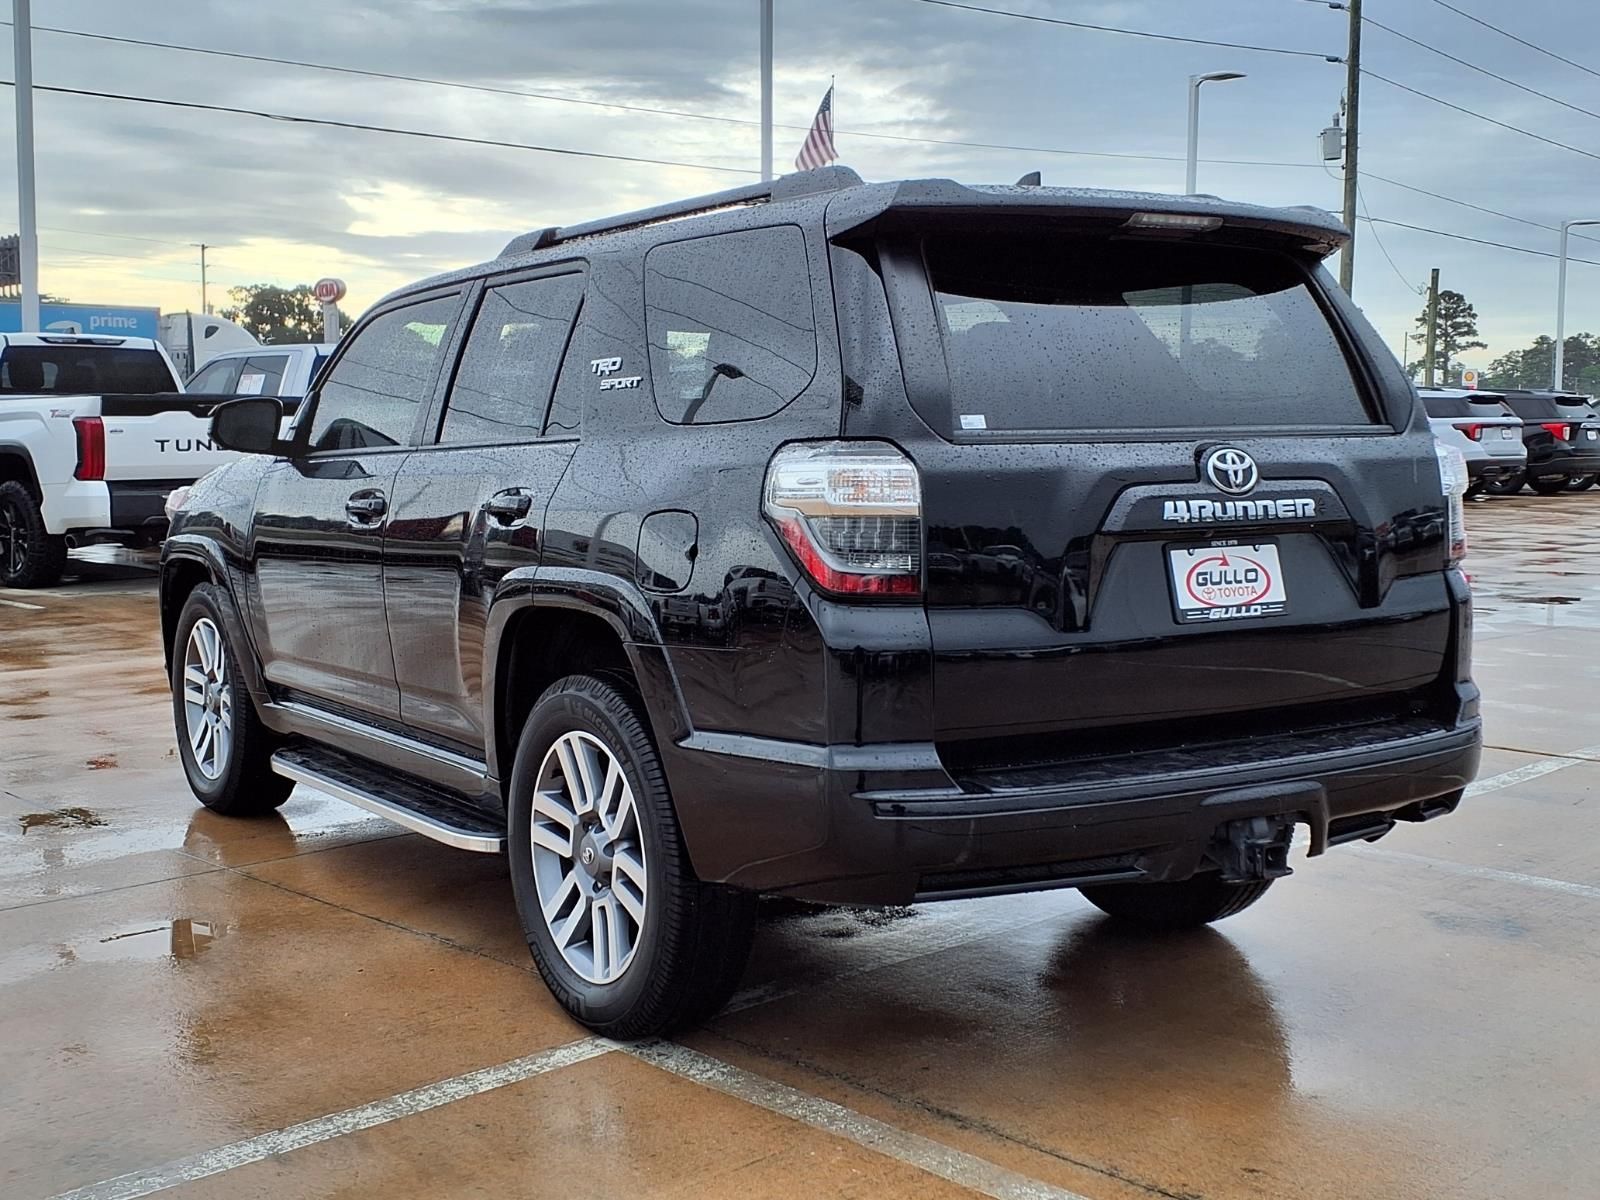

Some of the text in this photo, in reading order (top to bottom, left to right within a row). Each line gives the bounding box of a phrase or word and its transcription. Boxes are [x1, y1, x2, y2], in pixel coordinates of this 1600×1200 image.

[89, 313, 137, 329] prime
[590, 357, 622, 376] TRD
[600, 376, 642, 390] SPORT
[1163, 498, 1316, 523] 4RUNNER
[1196, 568, 1259, 587] GULLO
[1217, 585, 1258, 598] TOYOTA
[1208, 605, 1262, 619] GULLO
